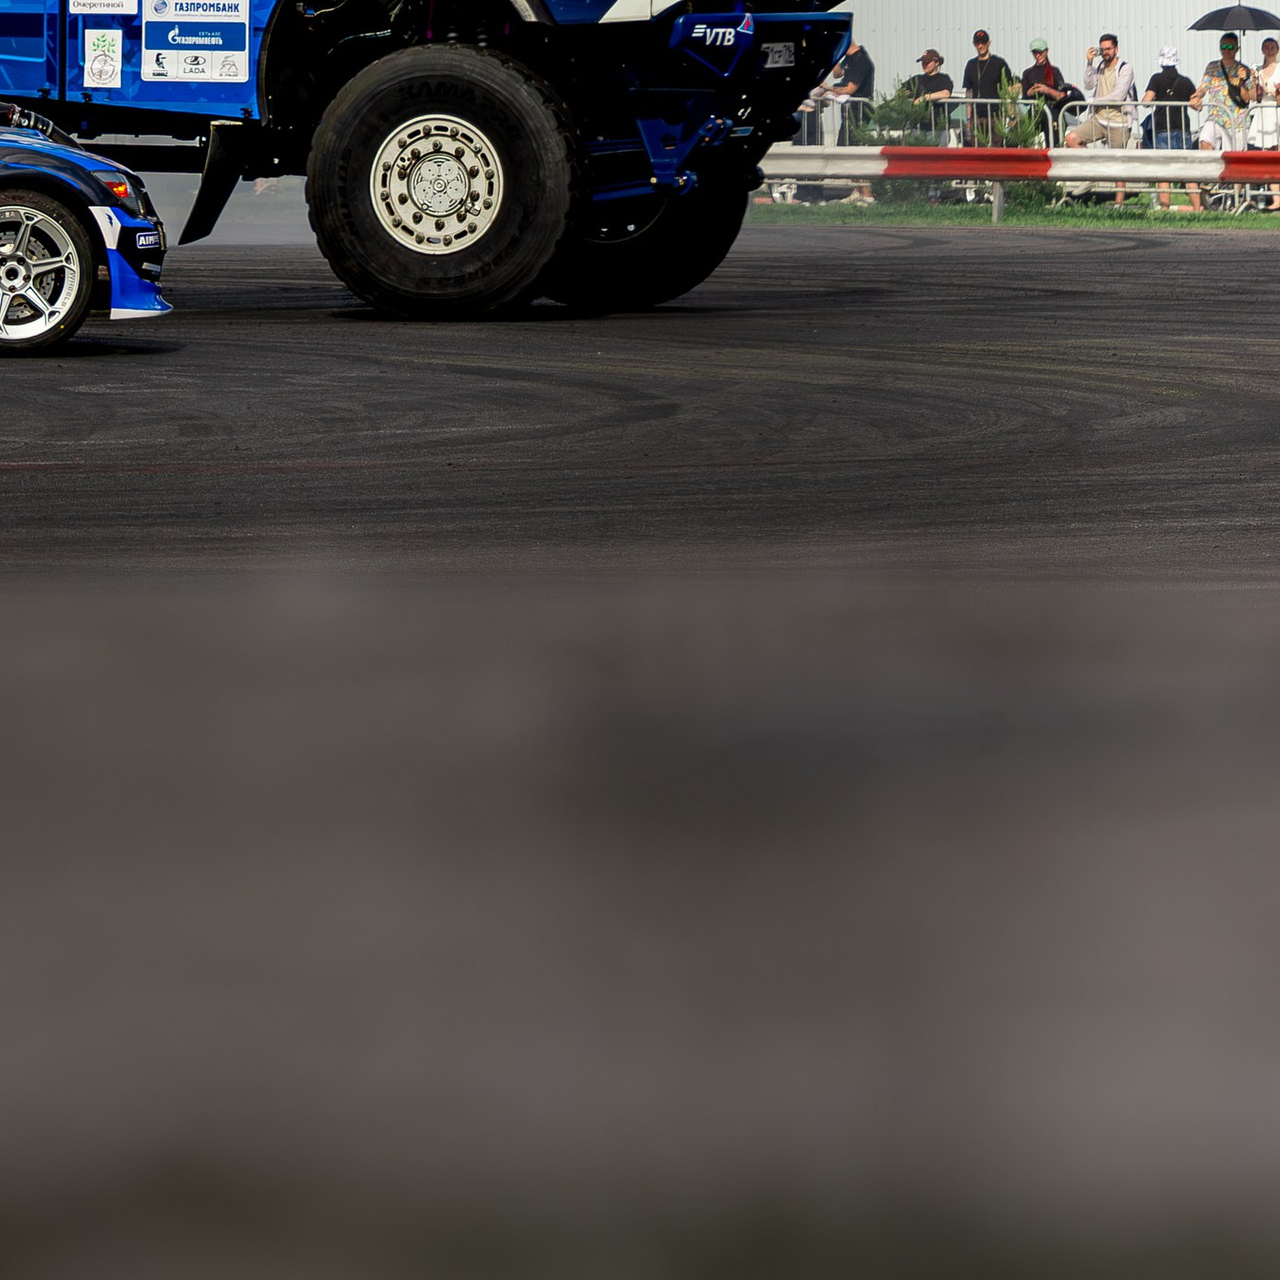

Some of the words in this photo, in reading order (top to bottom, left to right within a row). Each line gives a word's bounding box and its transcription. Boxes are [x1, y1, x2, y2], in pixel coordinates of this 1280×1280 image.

[174, 2, 240, 13] ГАЗПРОМБАНК
[705, 27, 736, 46] VTB
[183, 67, 207, 75] LADA
